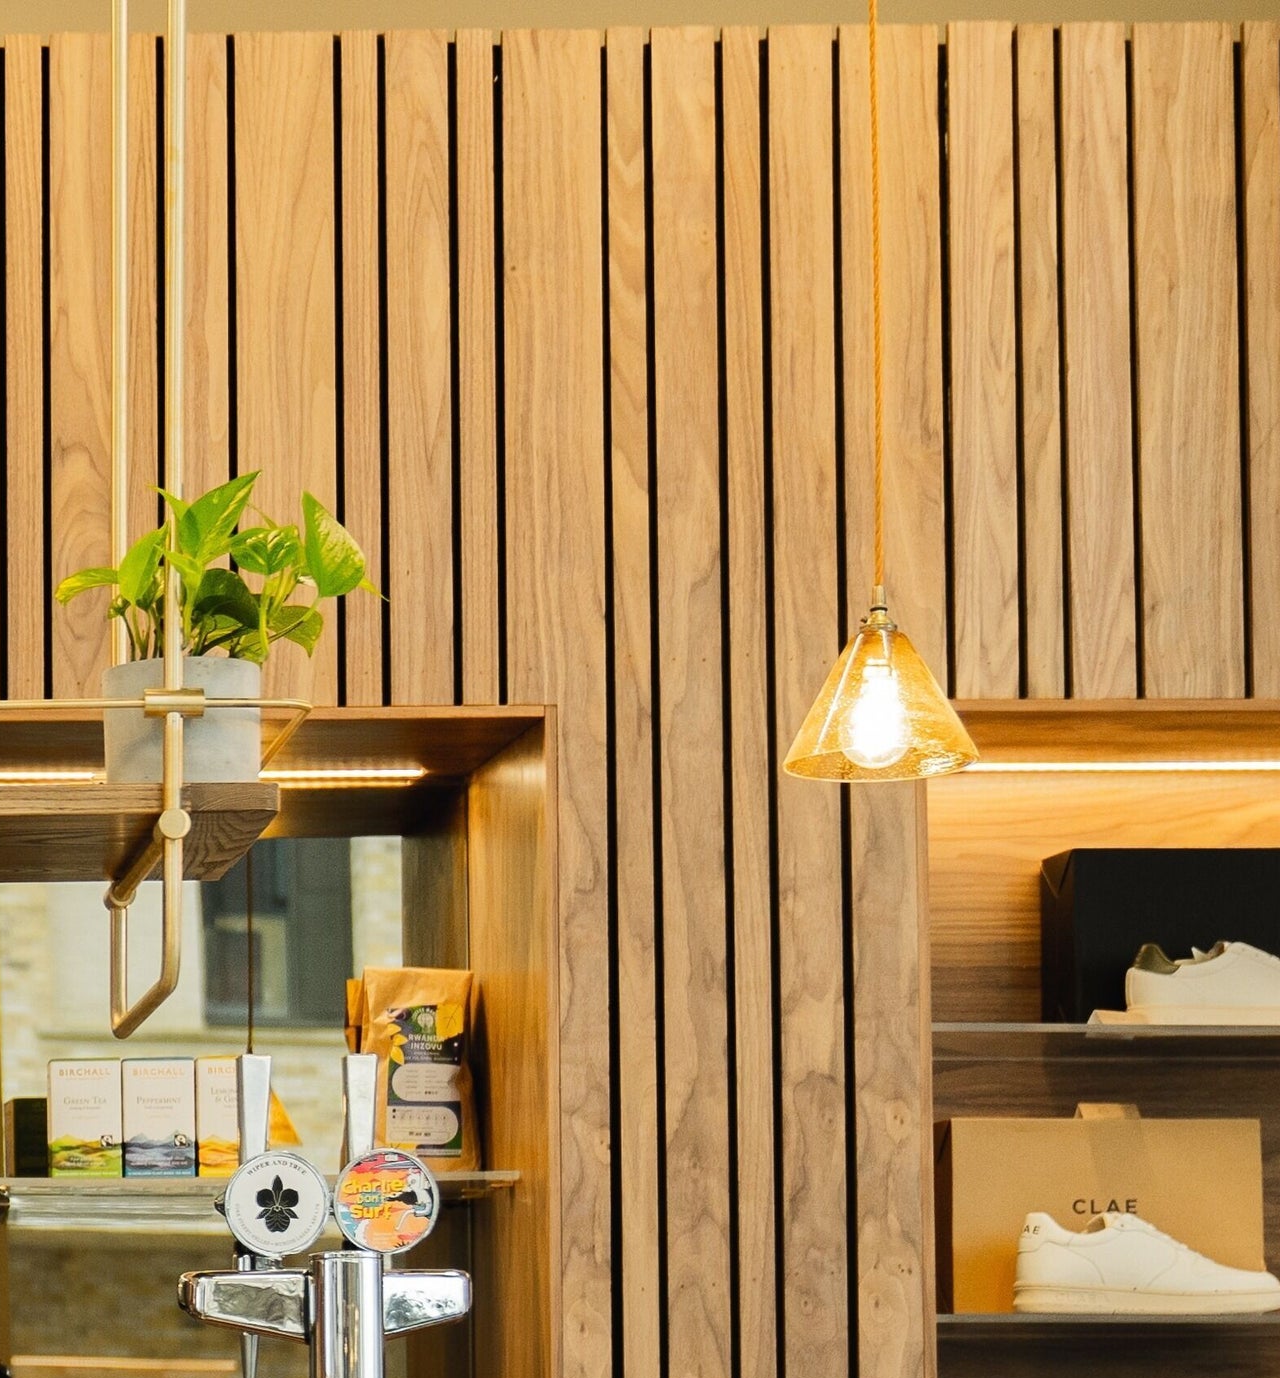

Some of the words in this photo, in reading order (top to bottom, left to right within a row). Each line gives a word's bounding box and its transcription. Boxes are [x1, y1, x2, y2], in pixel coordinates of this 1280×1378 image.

[59, 1068, 111, 1077] BIRCHALL
[132, 1067, 186, 1077] BIRCHALL
[247, 1160, 270, 1176] WIPER
[1072, 1199, 1138, 1214] CLAE
